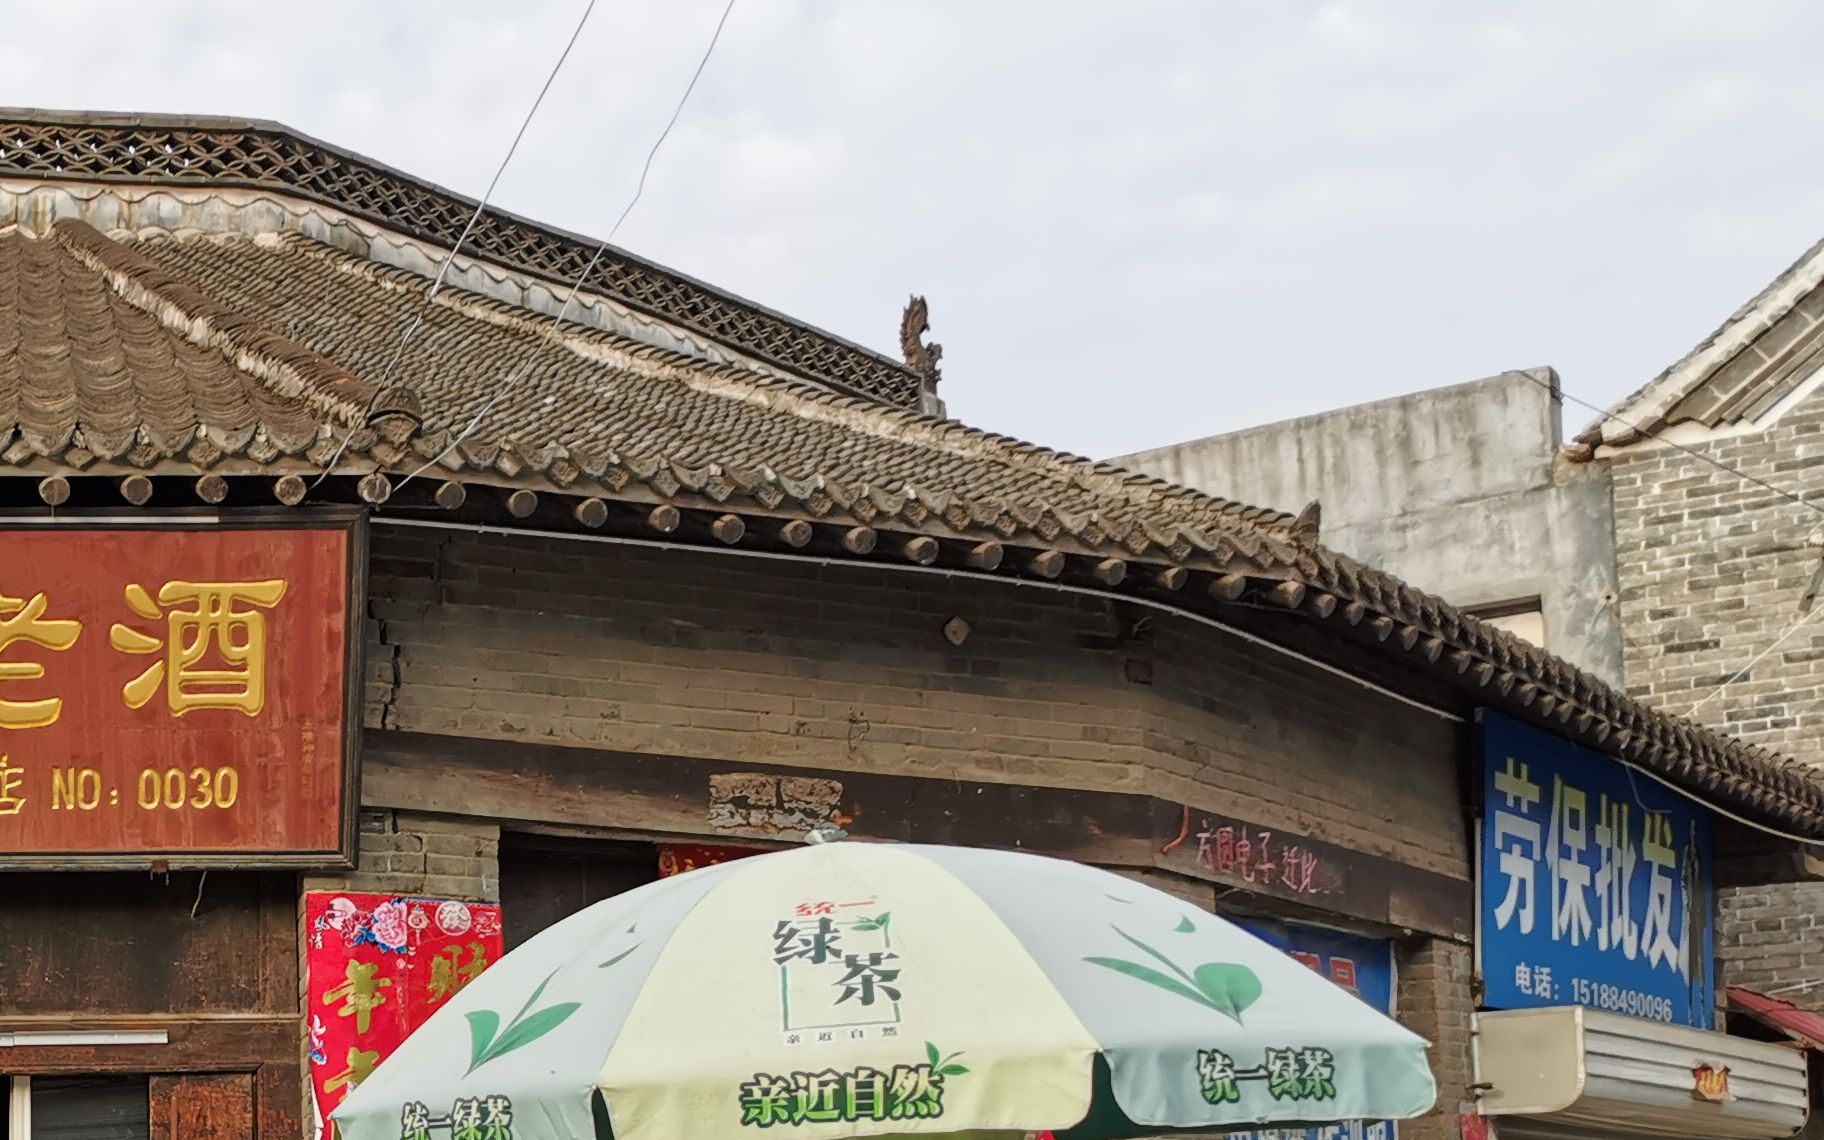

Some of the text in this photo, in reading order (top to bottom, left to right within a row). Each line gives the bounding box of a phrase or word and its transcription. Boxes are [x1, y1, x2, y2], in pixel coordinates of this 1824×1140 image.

[1494, 757, 1678, 973] 劳保批发
[773, 916, 902, 1006] 绿茶
[740, 1063, 944, 1128] 亲近自然
[1197, 1048, 1336, 1106] 统一绿茶
